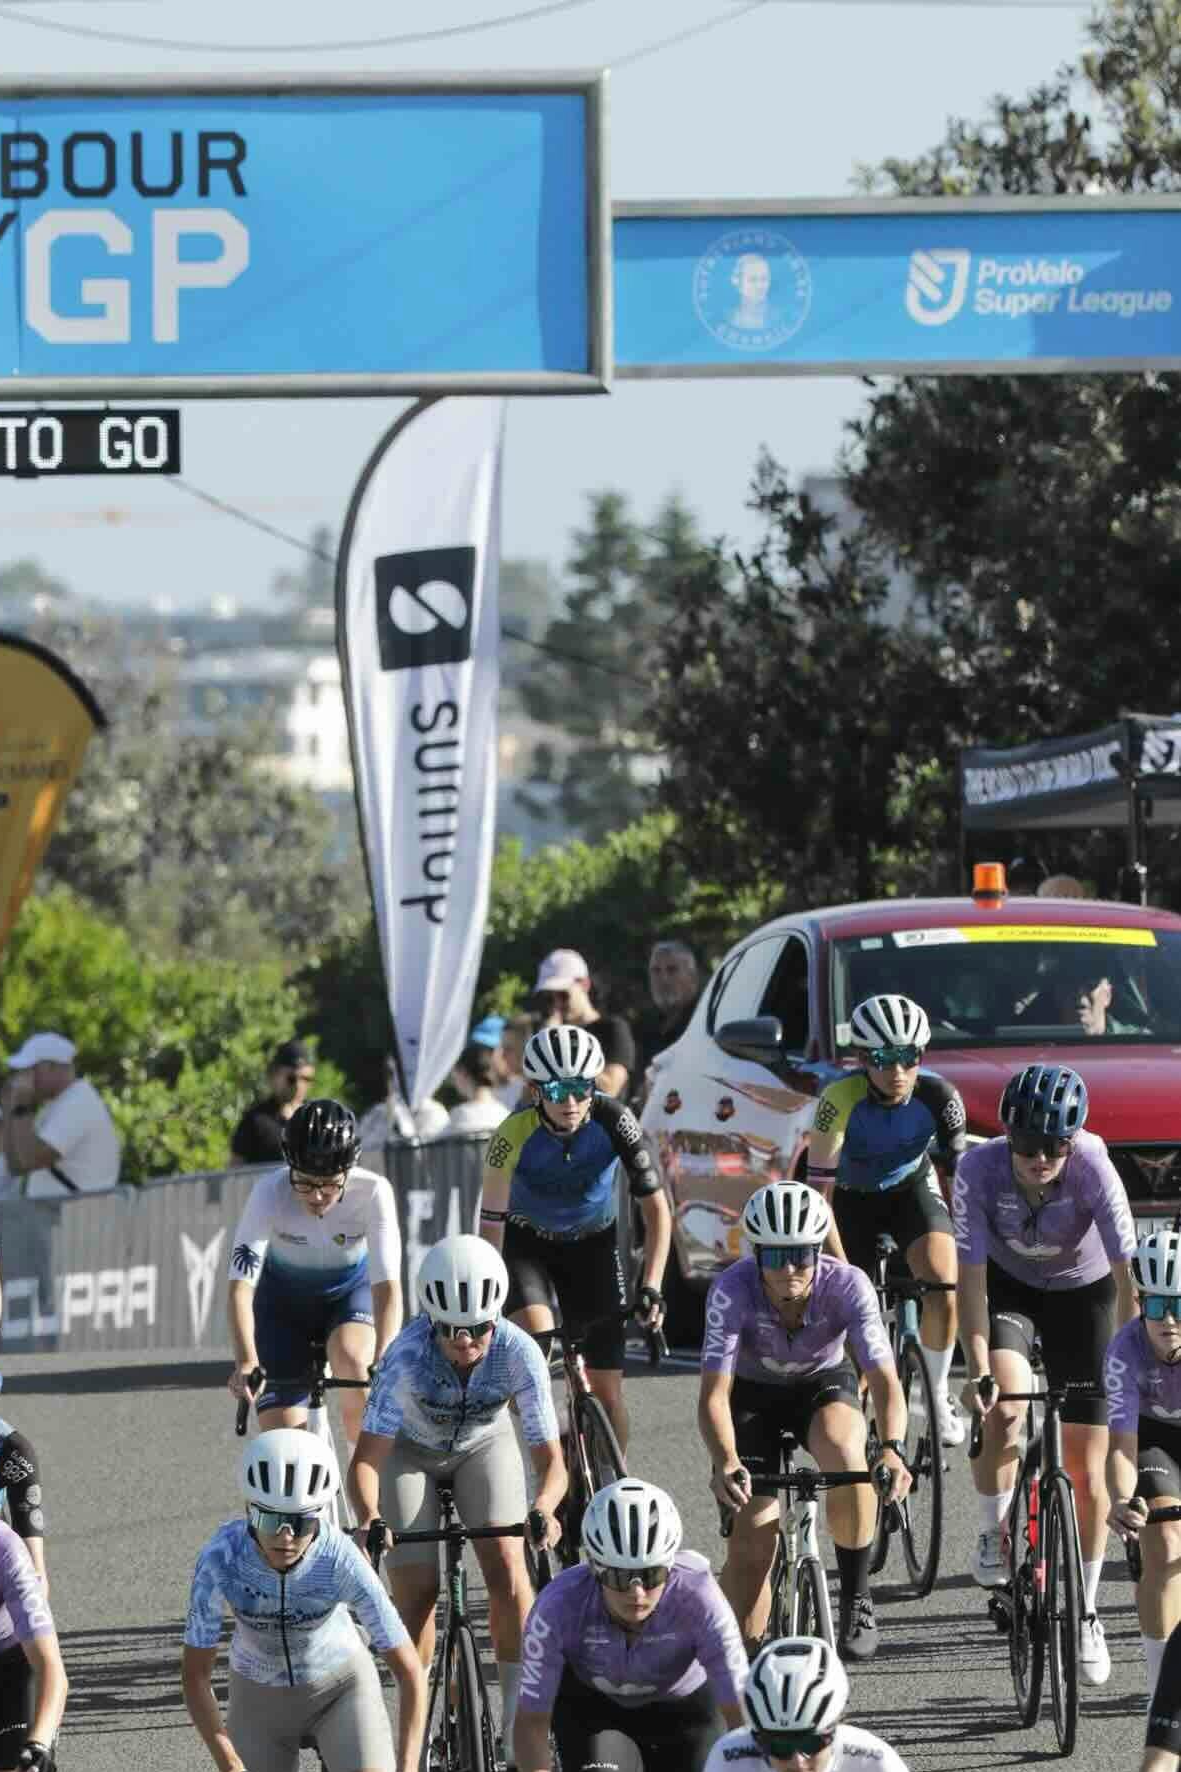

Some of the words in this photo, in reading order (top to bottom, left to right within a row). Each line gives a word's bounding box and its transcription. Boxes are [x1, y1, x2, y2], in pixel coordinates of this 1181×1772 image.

[25, 208, 250, 344] GP
[974, 287, 1060, 318] Super
[1068, 287, 1173, 317] League
[977, 259, 1085, 286] ProVelo
[99, 416, 169, 470] GO
[1105, 1356, 1127, 1425] DOVAL
[520, 1613, 551, 1699] DOVAL
